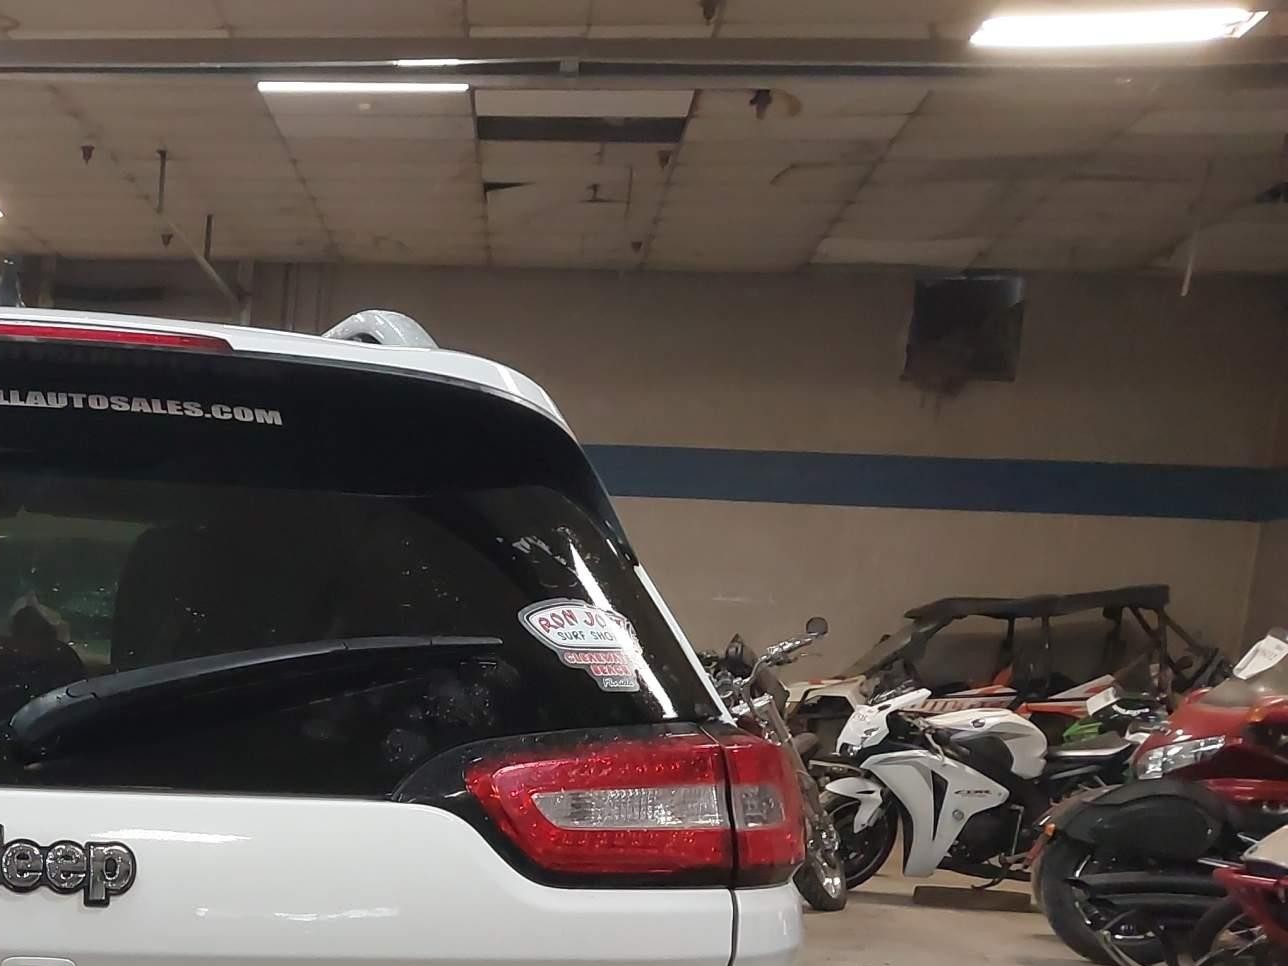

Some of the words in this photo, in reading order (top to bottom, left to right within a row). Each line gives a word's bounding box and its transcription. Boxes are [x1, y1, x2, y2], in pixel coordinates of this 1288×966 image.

[538, 609, 579, 634] RON
[557, 631, 586, 641] SURF
[591, 631, 617, 642] SHO
